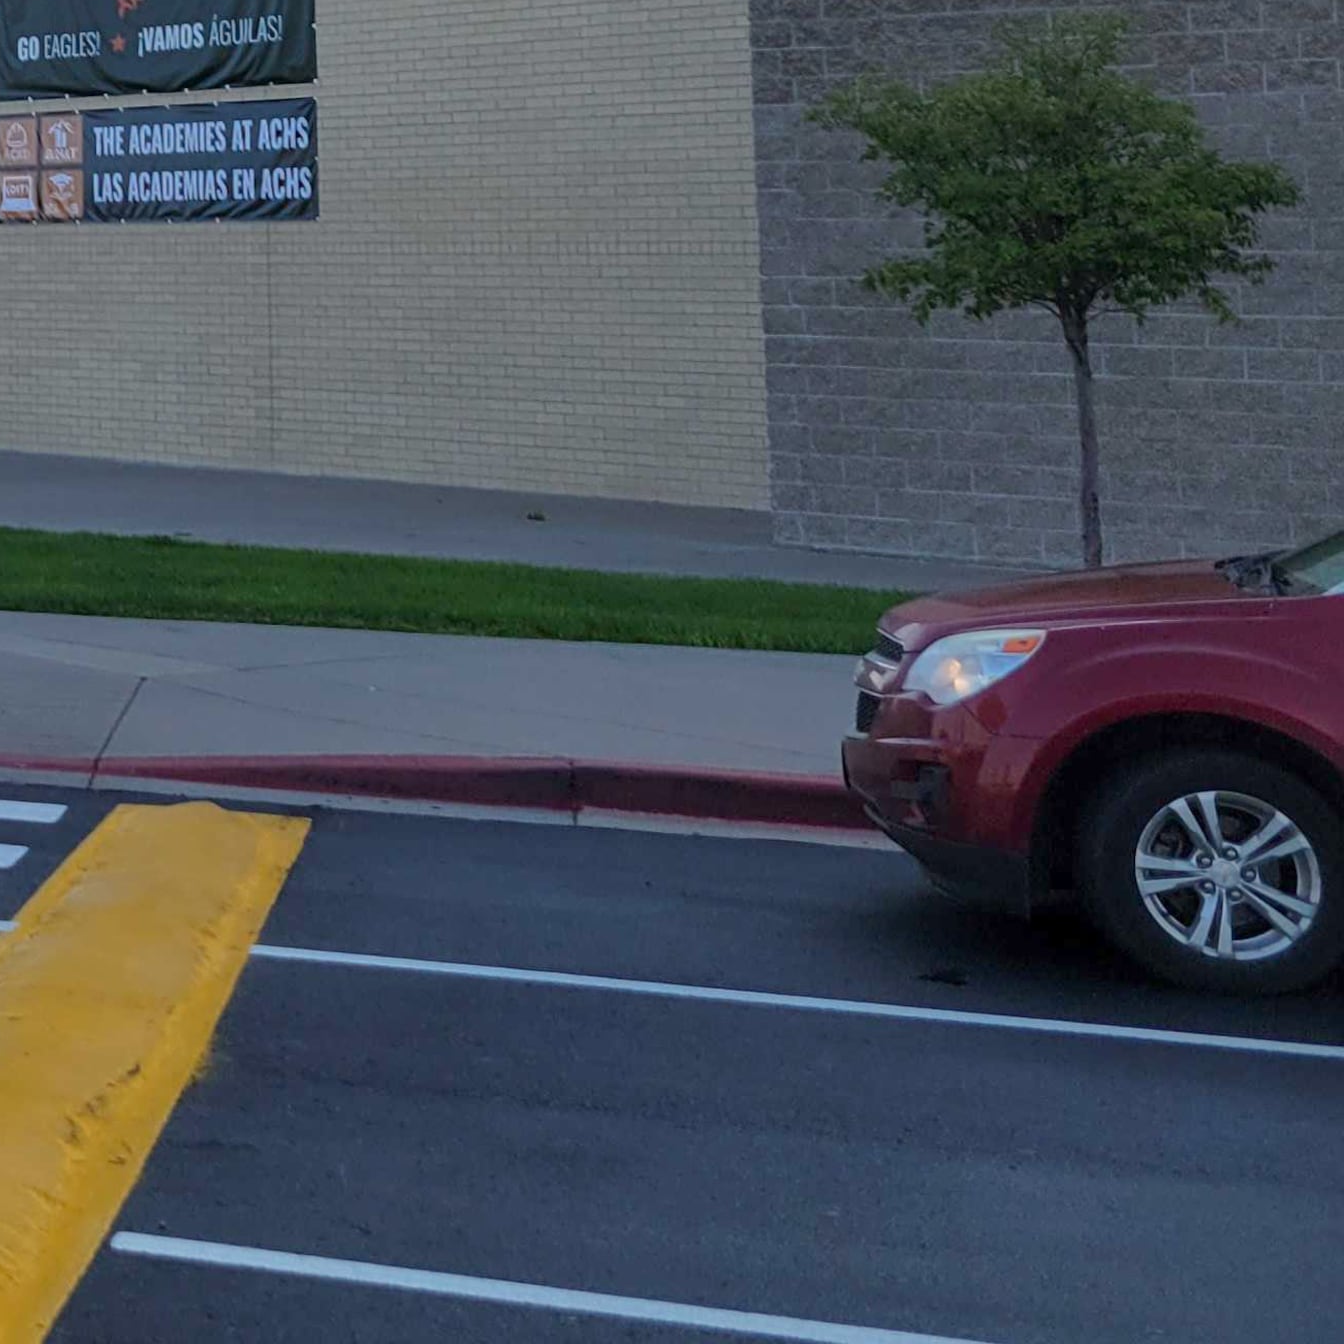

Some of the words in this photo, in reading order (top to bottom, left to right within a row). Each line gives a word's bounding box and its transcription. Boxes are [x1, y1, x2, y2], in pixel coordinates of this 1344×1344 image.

[17, 35, 40, 62] GO
[43, 31, 102, 58] EAGLES!
[93, 126, 125, 156] THE
[129, 121, 227, 154] ACADEMIES
[231, 120, 255, 151] AT
[260, 116, 311, 150] ACHS
[92, 172, 124, 203] LAS
[128, 169, 229, 203] ACADEMIAS
[233, 168, 256, 200] EN
[260, 167, 313, 200] ACHS
